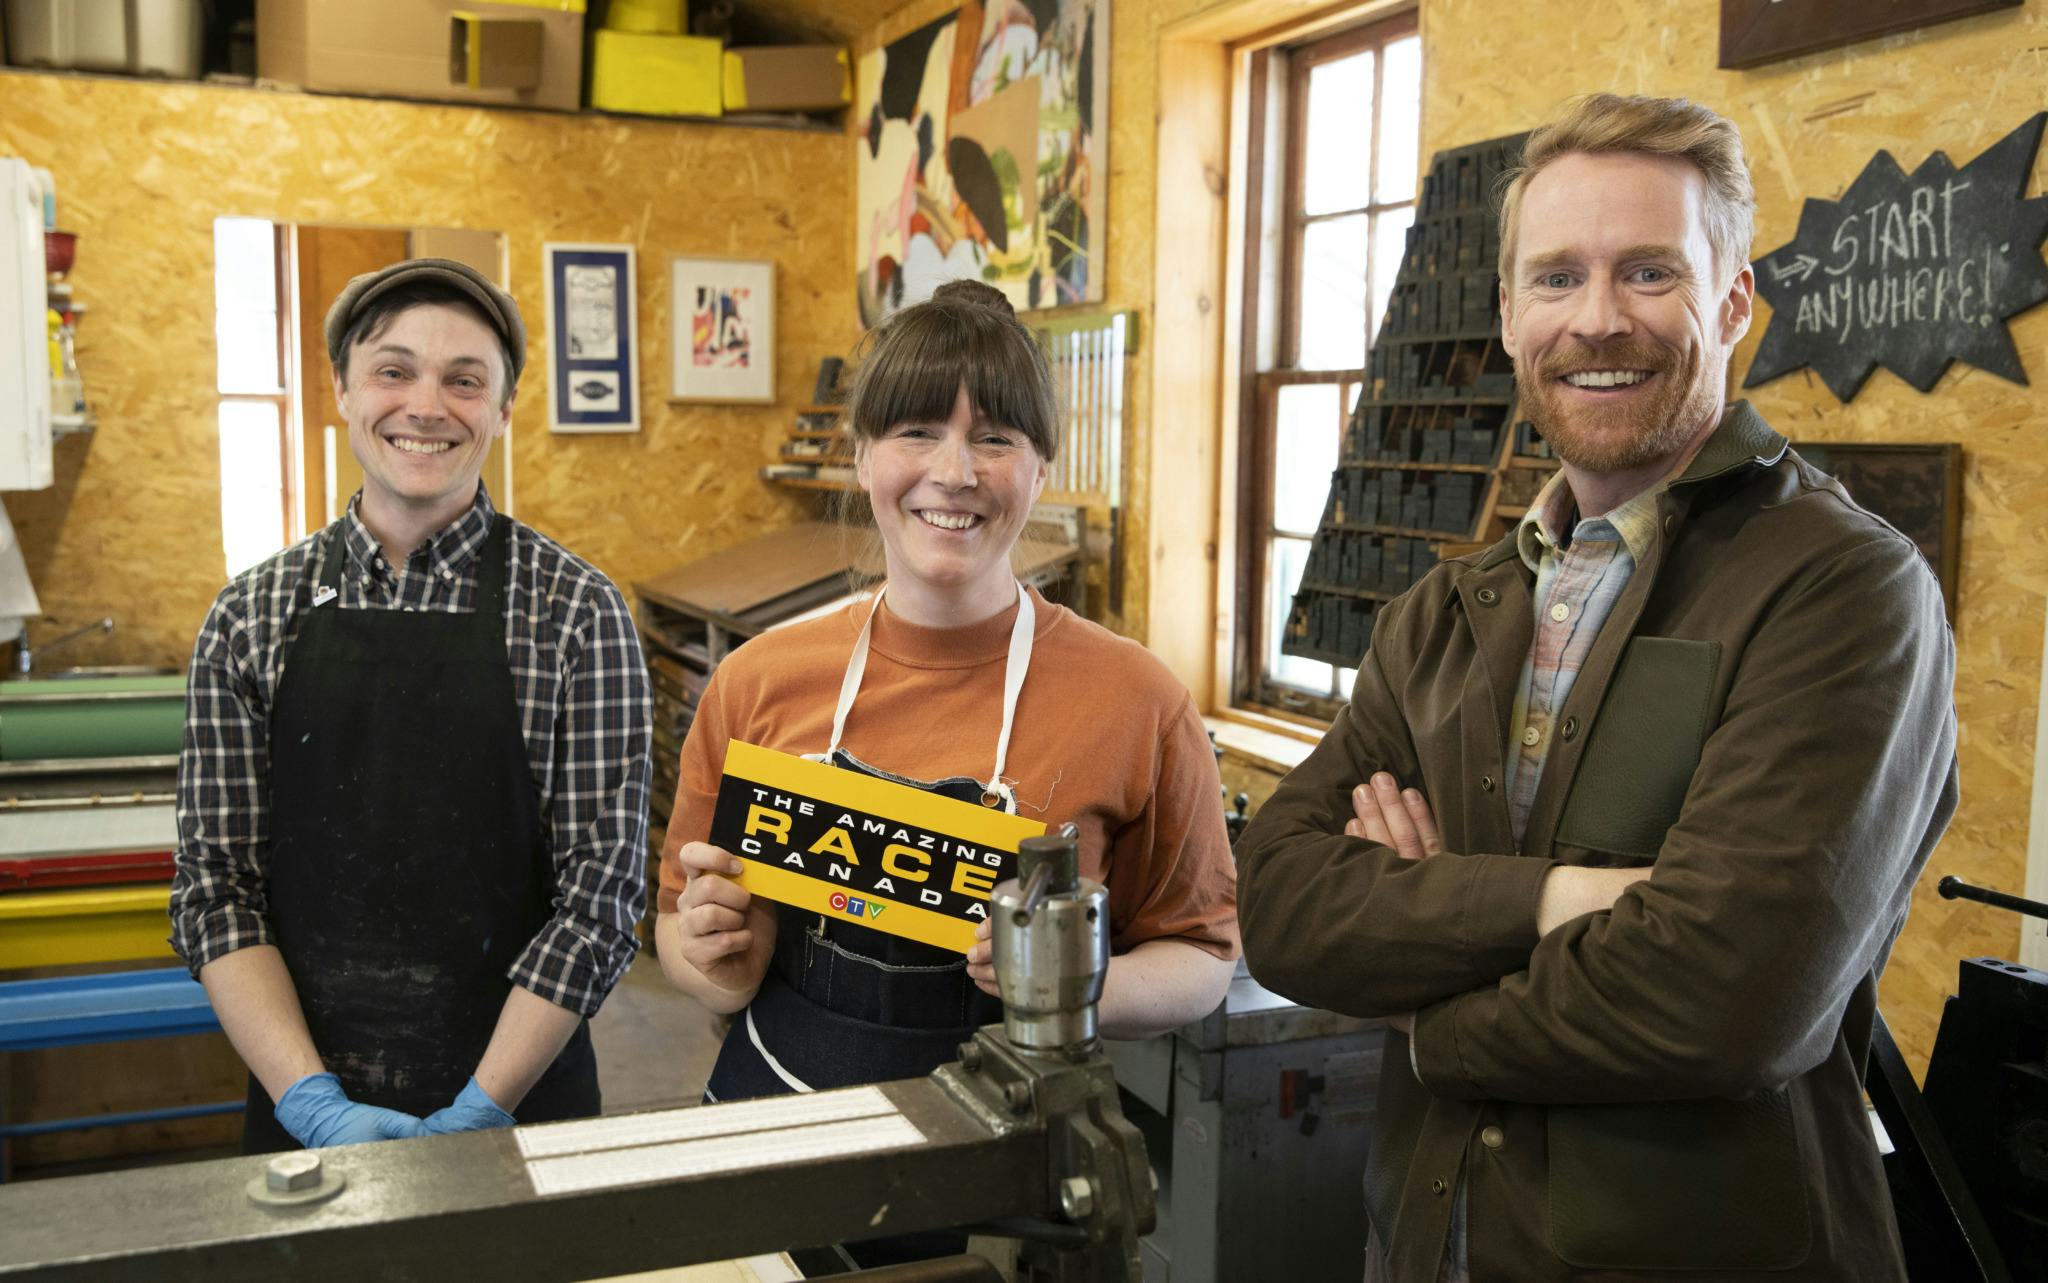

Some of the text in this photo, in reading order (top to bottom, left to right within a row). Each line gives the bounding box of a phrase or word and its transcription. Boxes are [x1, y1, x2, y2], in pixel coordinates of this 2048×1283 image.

[1824, 178, 1971, 276] START
[1795, 244, 1993, 345] ANYWHERE!
[744, 803, 998, 901] RACE
[753, 788, 1002, 867] THE AMAZING
[741, 838, 988, 918] CANADA
[830, 893, 885, 919] CTV
